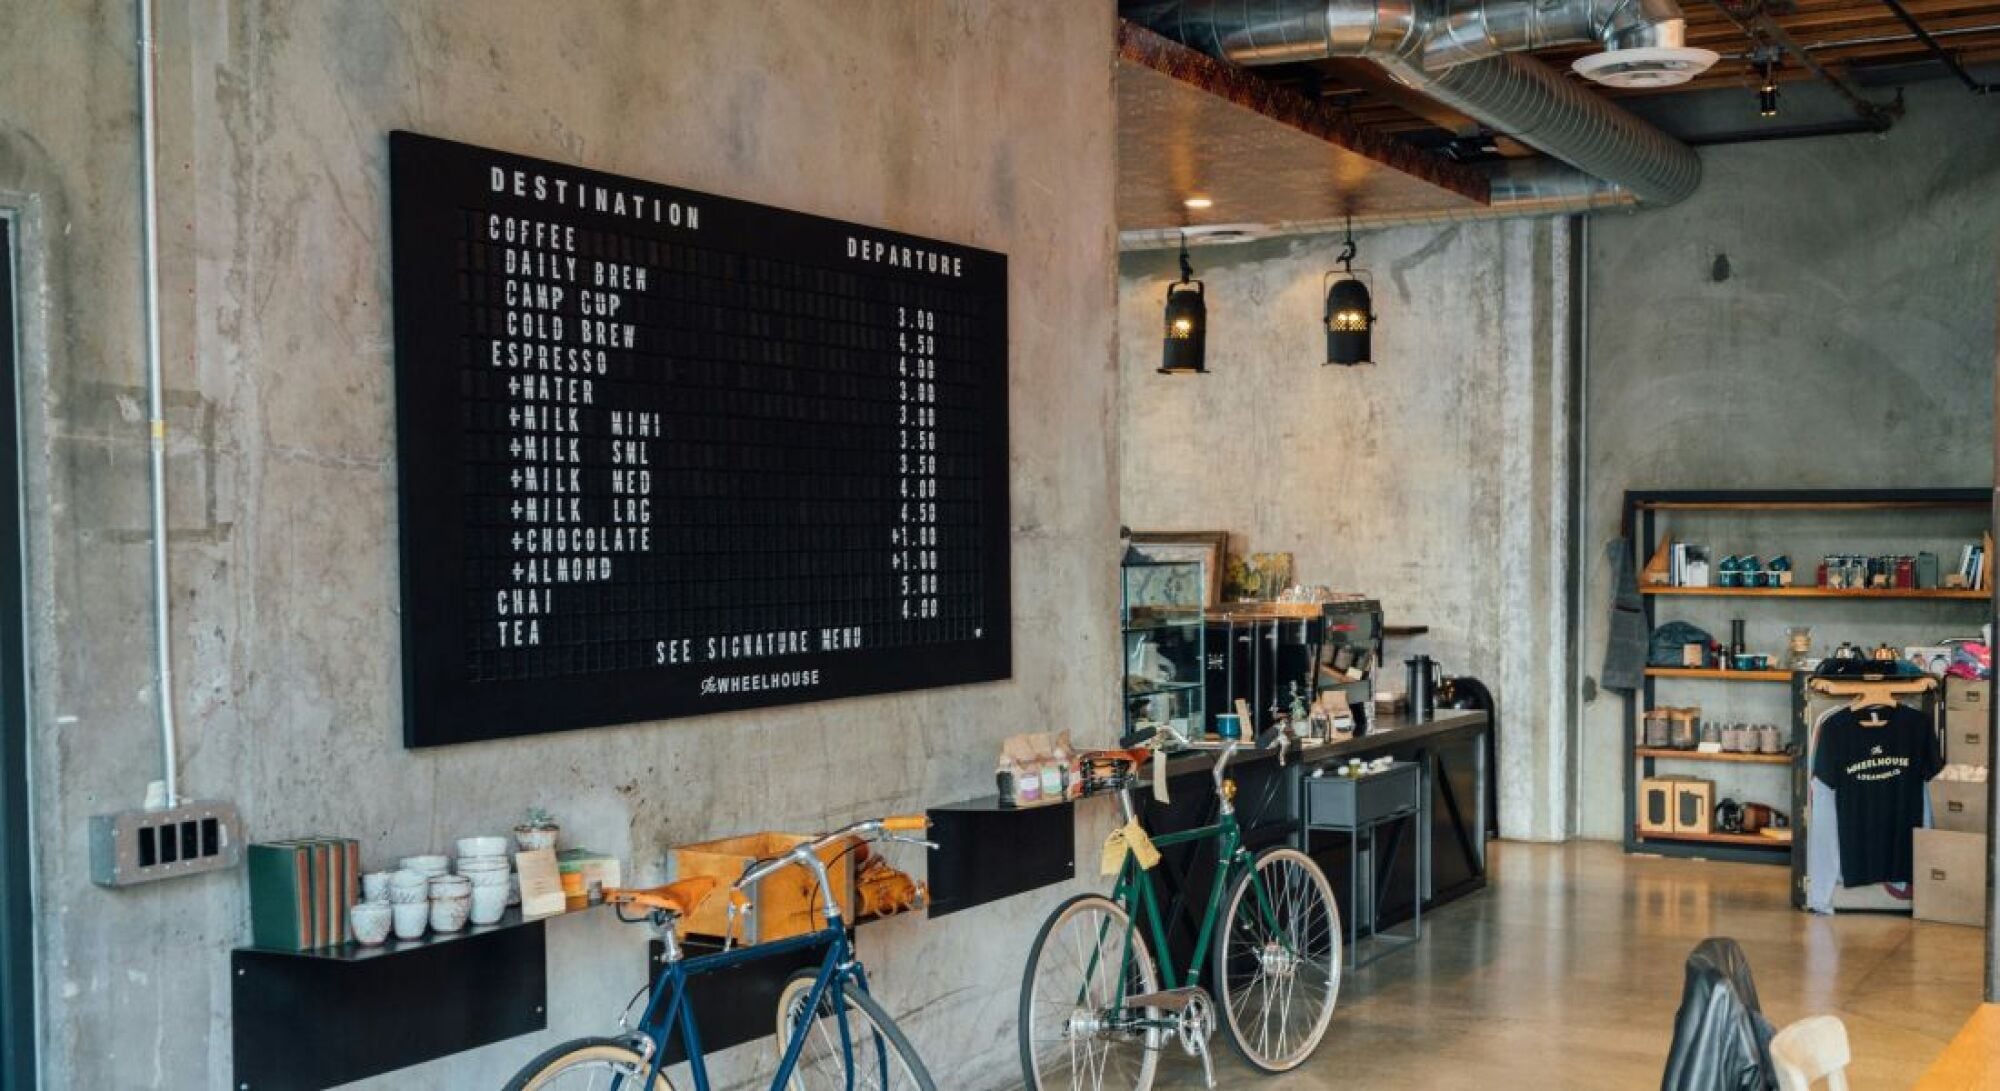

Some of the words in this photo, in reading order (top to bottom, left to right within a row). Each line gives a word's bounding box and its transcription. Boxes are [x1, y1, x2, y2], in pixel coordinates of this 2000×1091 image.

[490, 166, 699, 230] DESTINATION
[489, 214, 575, 252] COFFEE
[847, 237, 961, 277] DEPARTURE
[506, 248, 576, 282] DAILY
[595, 261, 646, 292] BREW
[899, 306, 934, 332] 3.00
[506, 279, 564, 310] CAMP
[581, 290, 621, 317] CUP
[899, 332, 934, 356] 4.50
[507, 310, 563, 341] COLD
[581, 319, 635, 349] BREW
[899, 356, 934, 380] 4.00
[492, 339, 607, 375] ESPRESSO
[899, 380, 935, 403] 3.00
[508, 374, 593, 405] +WATER
[899, 404, 935, 427] 3.00
[508, 404, 579, 432] +MILK
[611, 410, 660, 437] MINI
[900, 430, 936, 452] 3.50
[510, 435, 581, 463] +MILK
[612, 439, 648, 465] SML
[900, 453, 936, 475] 3.50
[510, 466, 581, 493] +MILK
[612, 469, 650, 495] MED
[900, 477, 936, 499] 4.00
[510, 497, 581, 523] +MILK
[613, 497, 650, 524] LRG
[901, 502, 936, 523] 4.50
[511, 526, 650, 554] +CHOCOLATE
[512, 556, 612, 584] +ALMOND
[497, 588, 551, 616] CHAI
[901, 574, 937, 596] 5.00
[497, 619, 539, 648] TEA
[902, 597, 938, 620] 4.00
[656, 639, 692, 665] SEE
[708, 630, 808, 660] SIGNATURE
[821, 626, 861, 651] MENU
[717, 670, 819, 694] WHEELHOUSE
